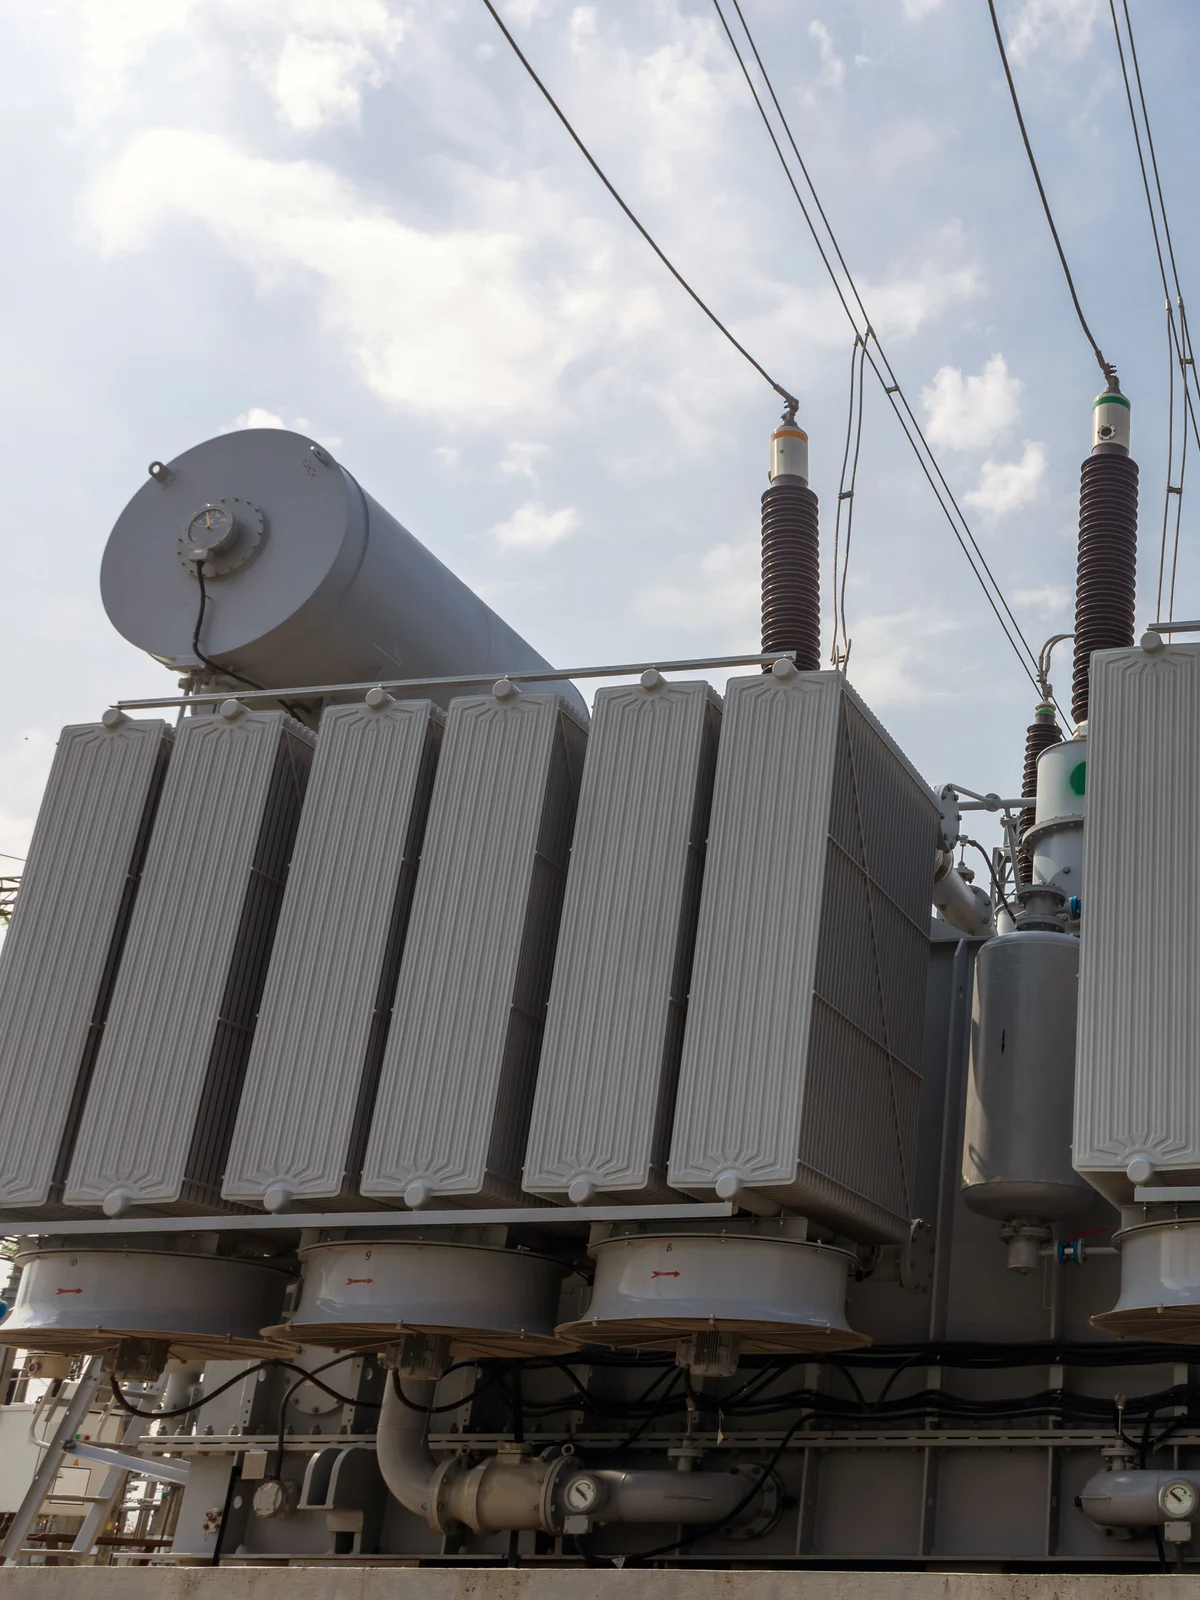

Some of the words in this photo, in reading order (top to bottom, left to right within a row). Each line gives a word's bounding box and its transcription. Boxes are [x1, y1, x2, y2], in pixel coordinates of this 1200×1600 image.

[666, 1243, 673, 1252] 8
[365, 1250, 372, 1261] 9
[69, 1257, 78, 1267] 10
